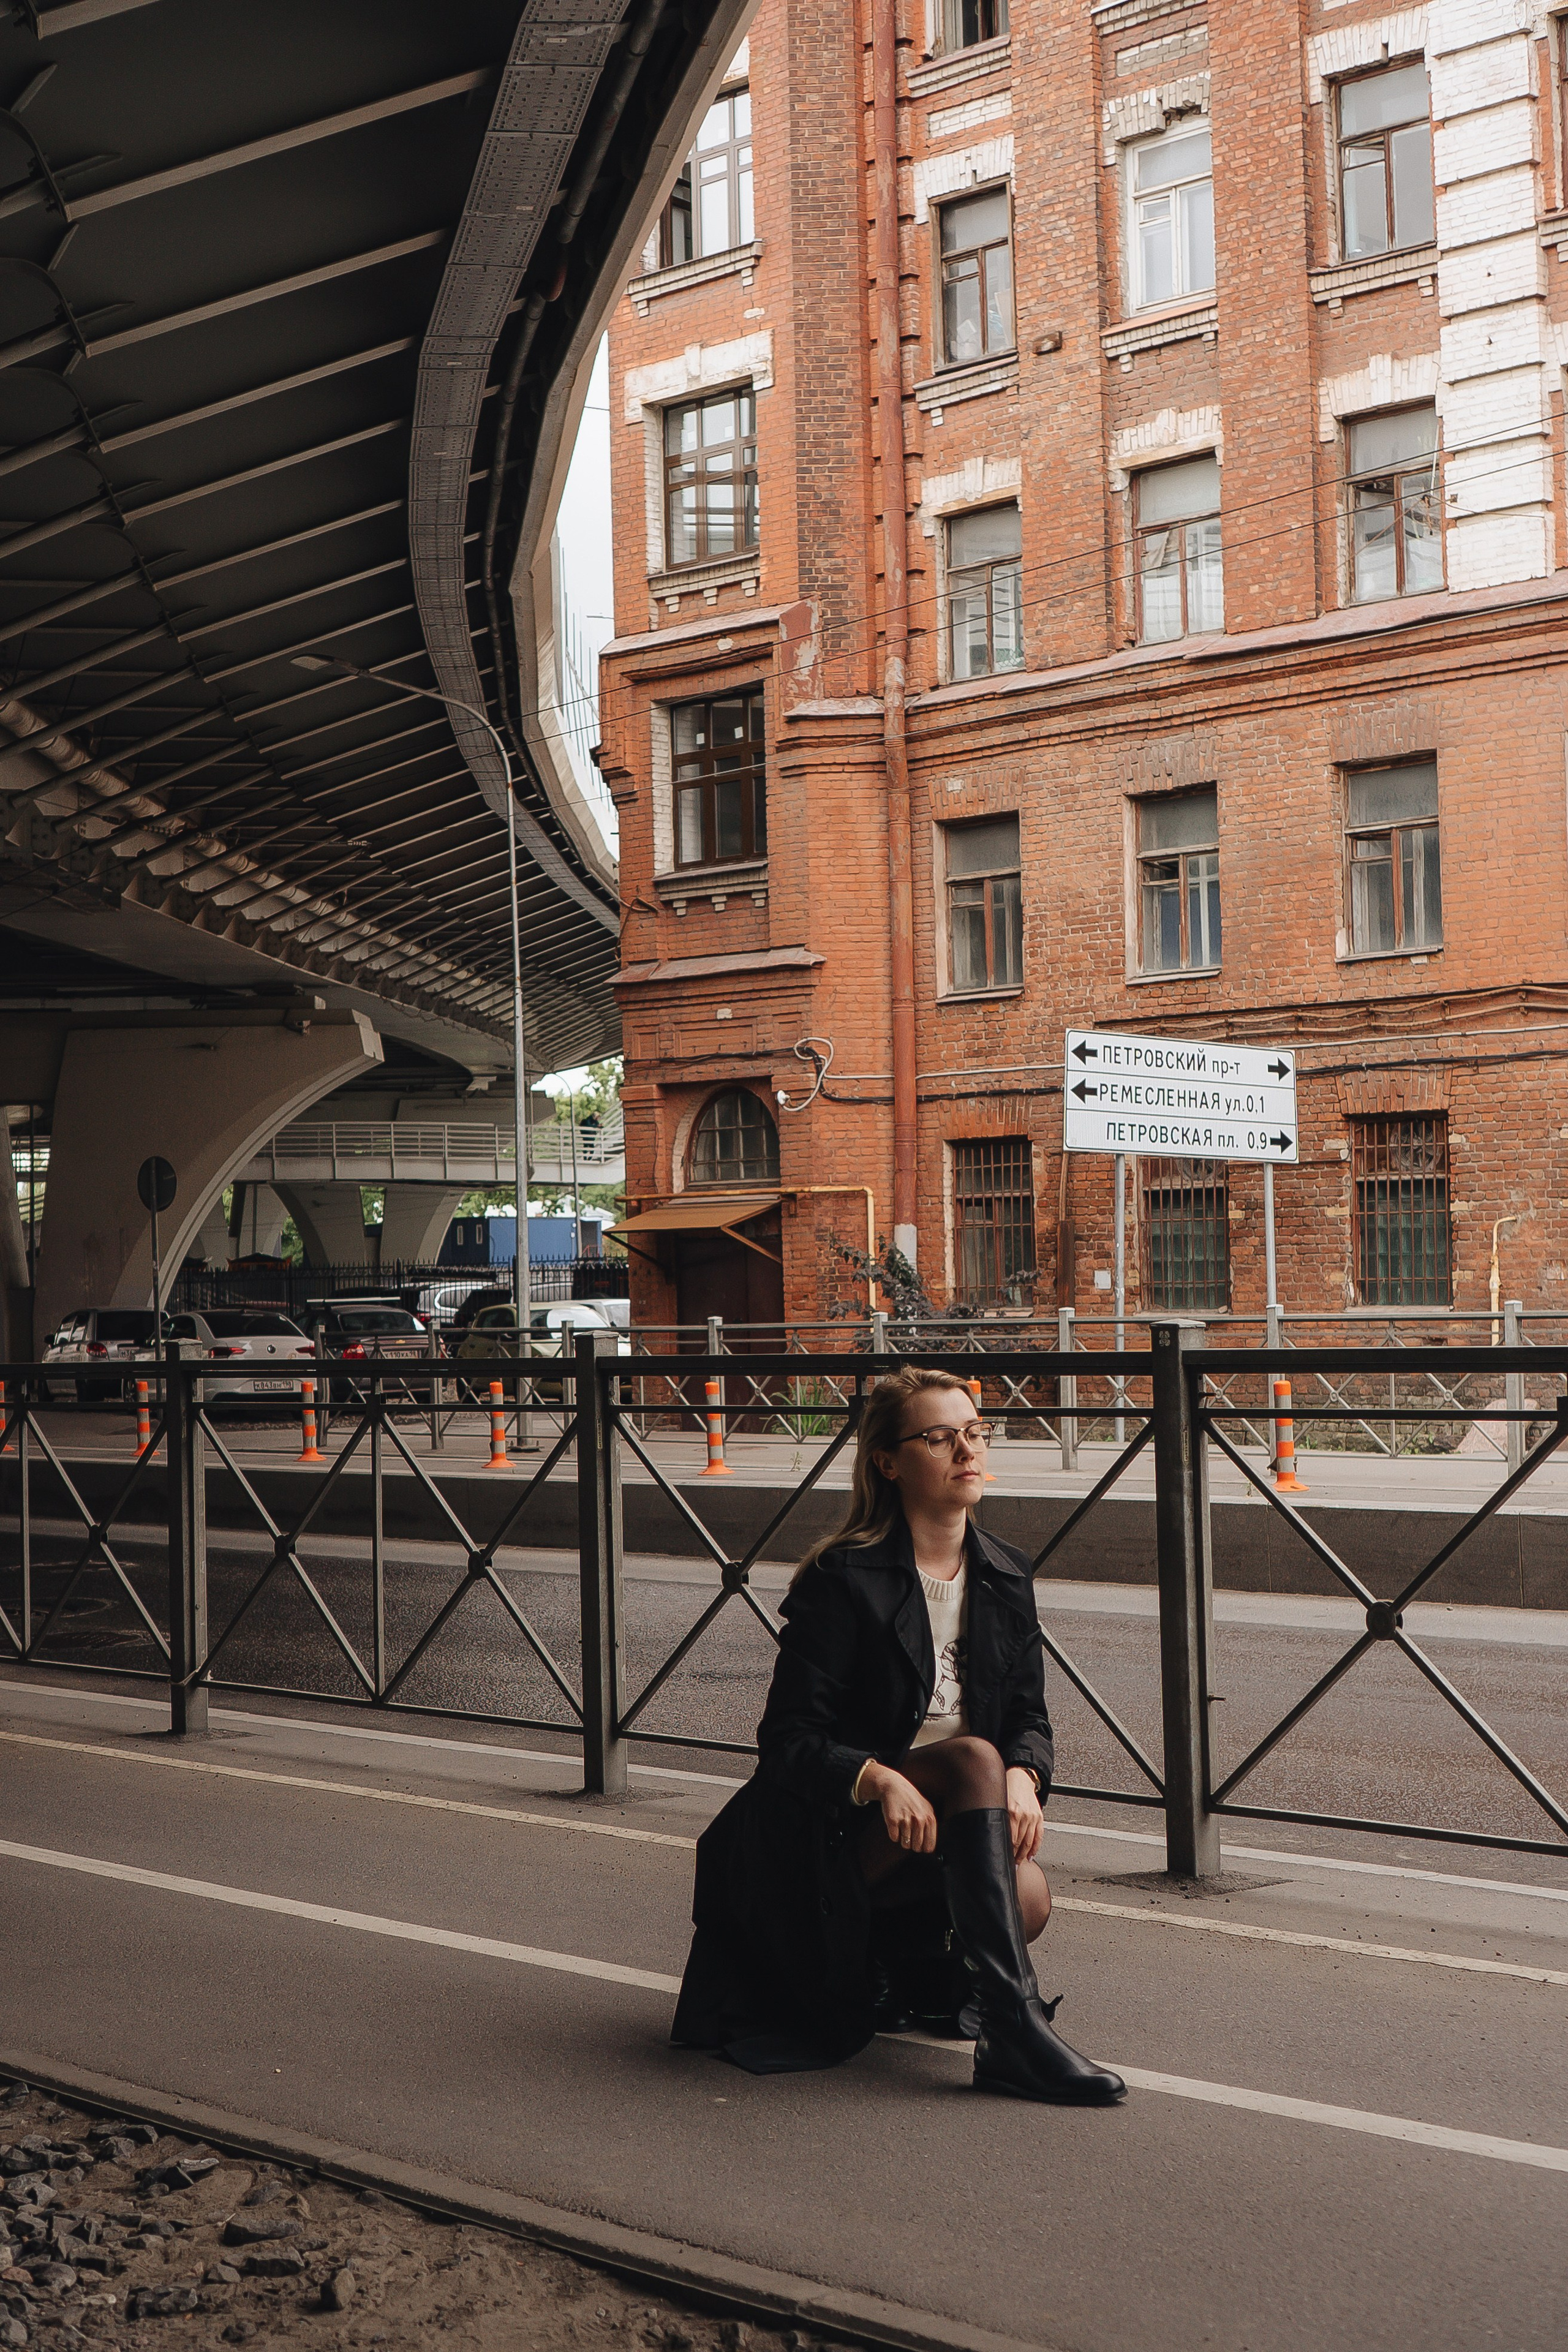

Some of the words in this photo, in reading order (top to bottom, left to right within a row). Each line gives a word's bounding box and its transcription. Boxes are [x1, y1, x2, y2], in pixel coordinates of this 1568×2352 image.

[1102, 1044, 1206, 1072] ПЕТРОВСКИЙ
[1212, 1060, 1240, 1079] пр-т
[1099, 1082, 1220, 1110] РЕМЕСЛЕННАЯ
[1107, 1121, 1212, 1147] ПЕТРОВСКАЯ
[1218, 1134, 1238, 1148] пл.
[1247, 1131, 1267, 1151] 0,9
